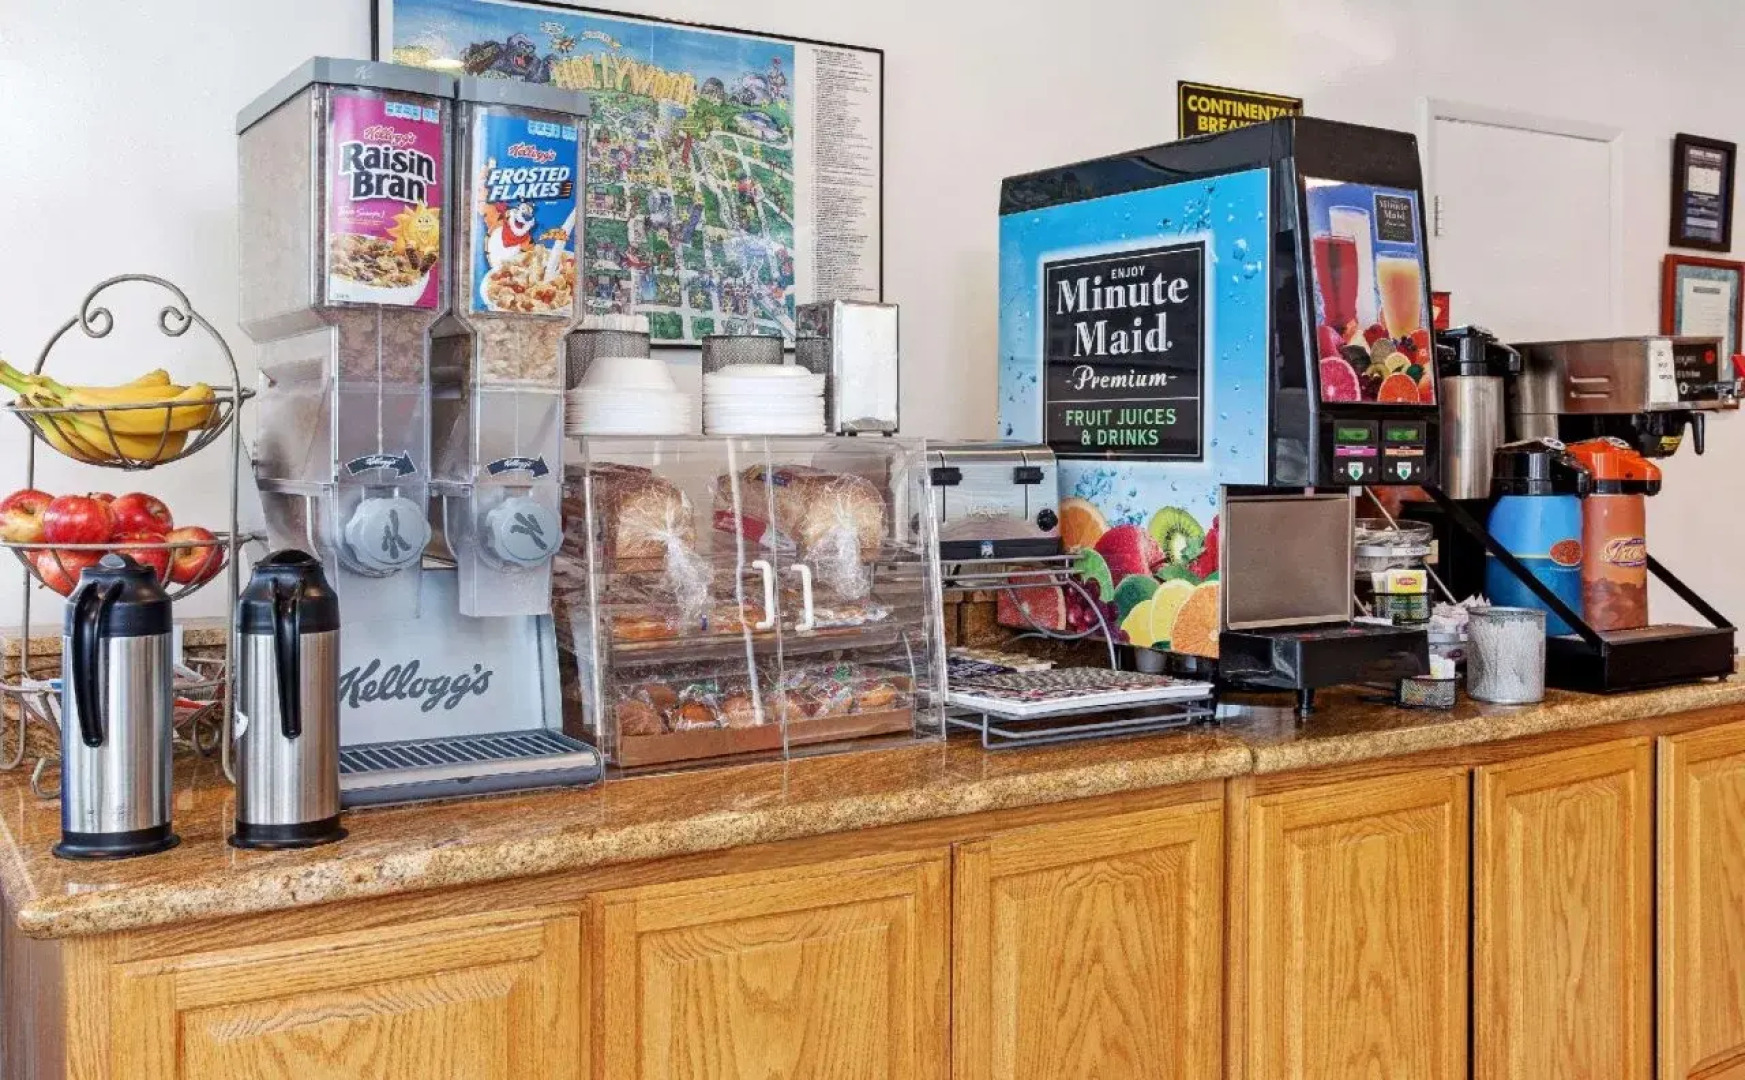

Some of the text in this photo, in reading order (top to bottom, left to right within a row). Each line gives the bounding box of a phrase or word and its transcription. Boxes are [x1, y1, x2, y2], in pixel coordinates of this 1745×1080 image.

[340, 141, 436, 184] Raisin
[488, 167, 570, 186] FROSTED
[350, 170, 427, 204] Bran
[490, 182, 560, 202] FLAKES
[1110, 265, 1146, 280] ENJOY
[1056, 272, 1190, 315] Minute
[1065, 408, 1177, 427] FRUIT JUICES
[1080, 428, 1160, 446] & DRINKS
[339, 657, 494, 713] Kellogg's
